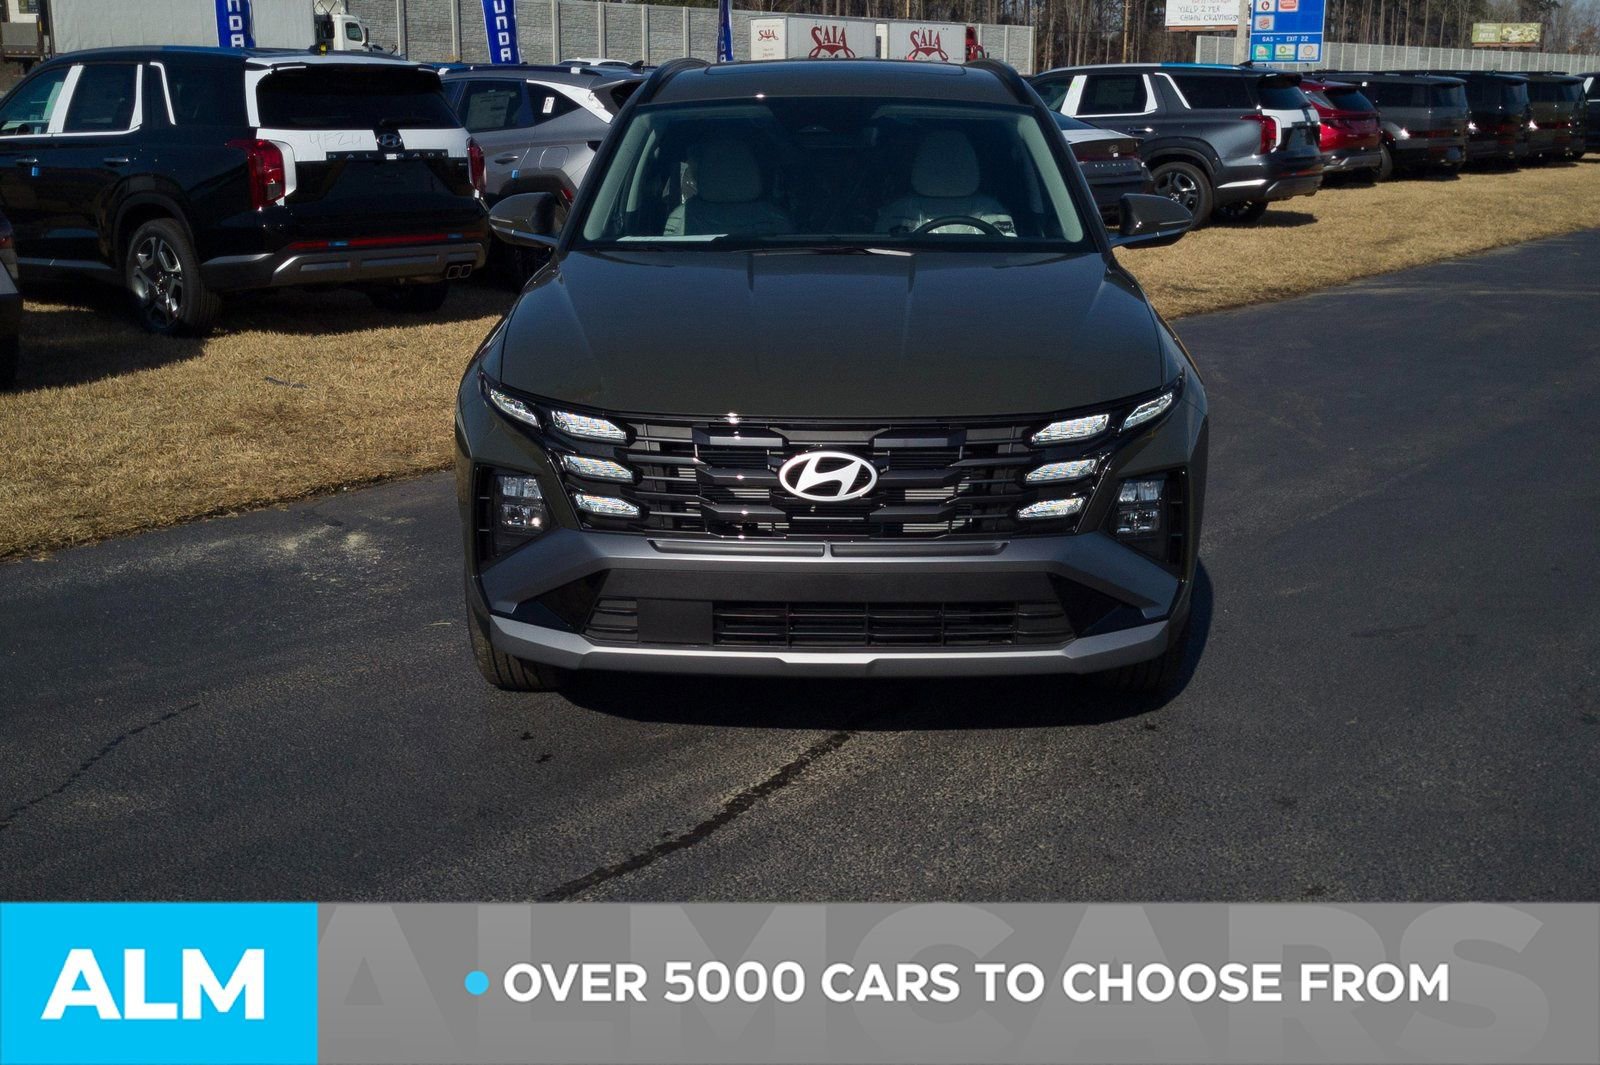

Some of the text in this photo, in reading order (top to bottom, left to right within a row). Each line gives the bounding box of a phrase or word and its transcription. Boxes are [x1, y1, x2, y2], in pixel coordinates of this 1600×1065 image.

[758, 29, 779, 41] SAIA
[809, 25, 855, 58] SAIA
[907, 29, 948, 62] SAIA
